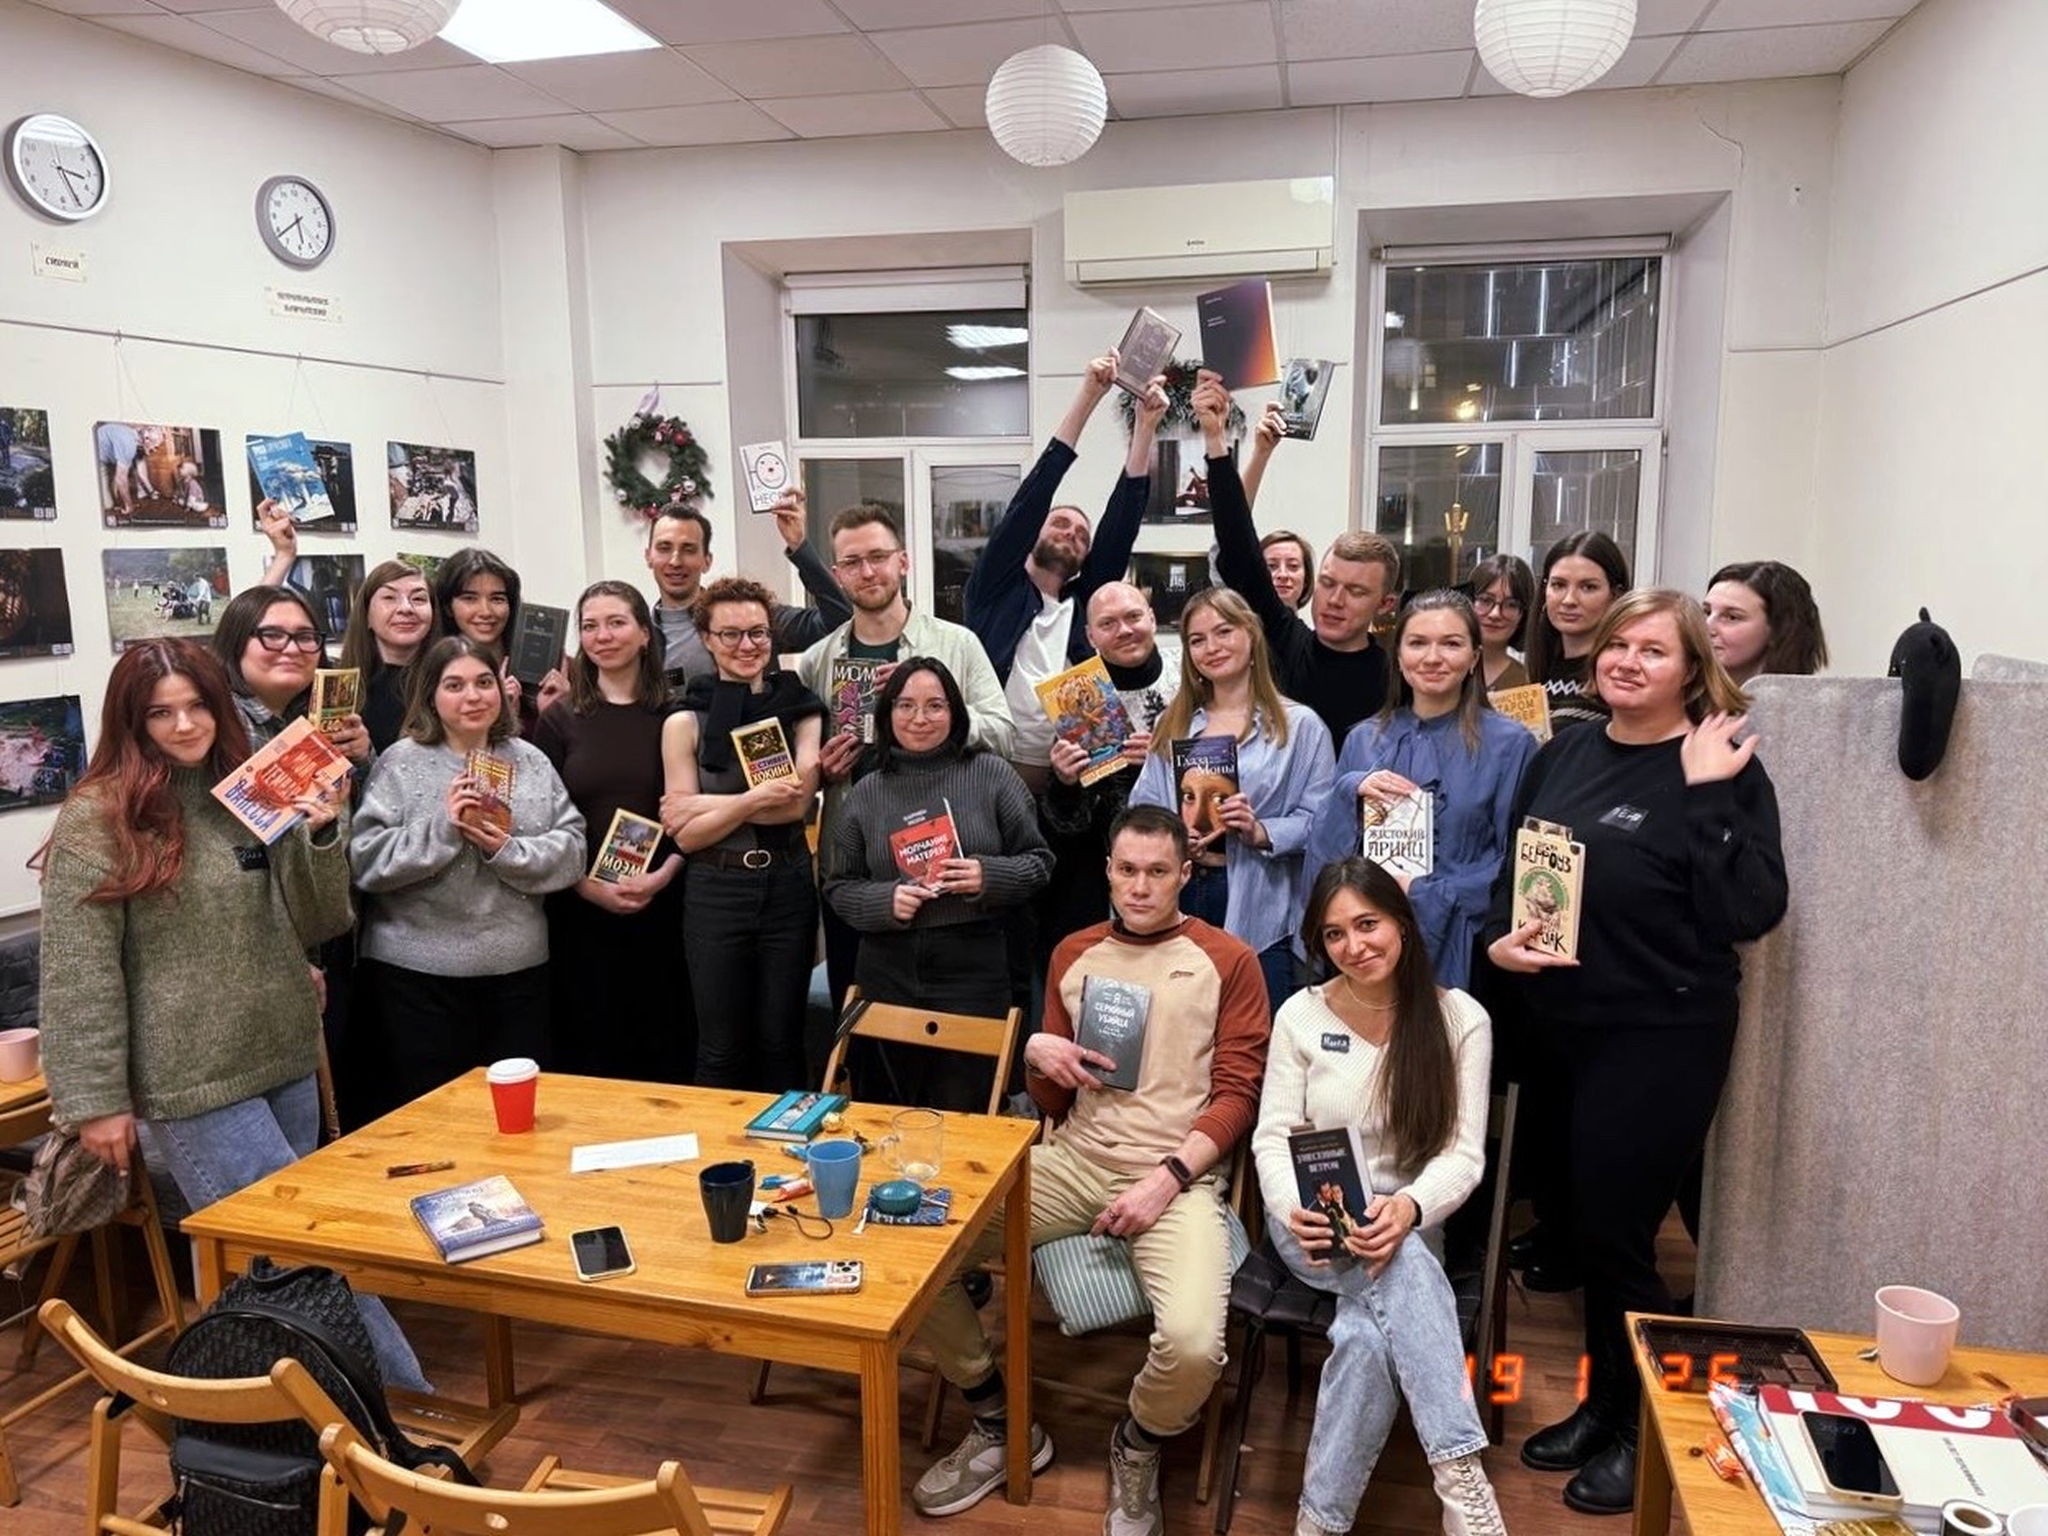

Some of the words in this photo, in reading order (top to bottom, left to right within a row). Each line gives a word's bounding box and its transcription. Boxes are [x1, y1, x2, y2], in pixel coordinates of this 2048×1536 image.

[833, 664, 878, 683] МИСИМ
[1496, 698, 1535, 712] ТАРОМ
[1176, 754, 1210, 767] Глаза
[1197, 763, 1235, 775] Моны
[751, 763, 790, 786] ХОКИНГ
[225, 778, 282, 832] ВАНЕССА
[1367, 828, 1425, 840] ЖЕСТОКИЙ
[899, 834, 949, 858] МОЛЧАНИЕ
[907, 845, 947, 865] МАТЕРЕЙ
[1368, 841, 1425, 858] ПРИНЦ
[601, 854, 643, 879] МОЭМ
[1520, 843, 1572, 873] БЕРРОУЗ
[1098, 1013, 1129, 1028] УБИЙЦА
[1308, 1161, 1340, 1174] ВЕТРОМ
